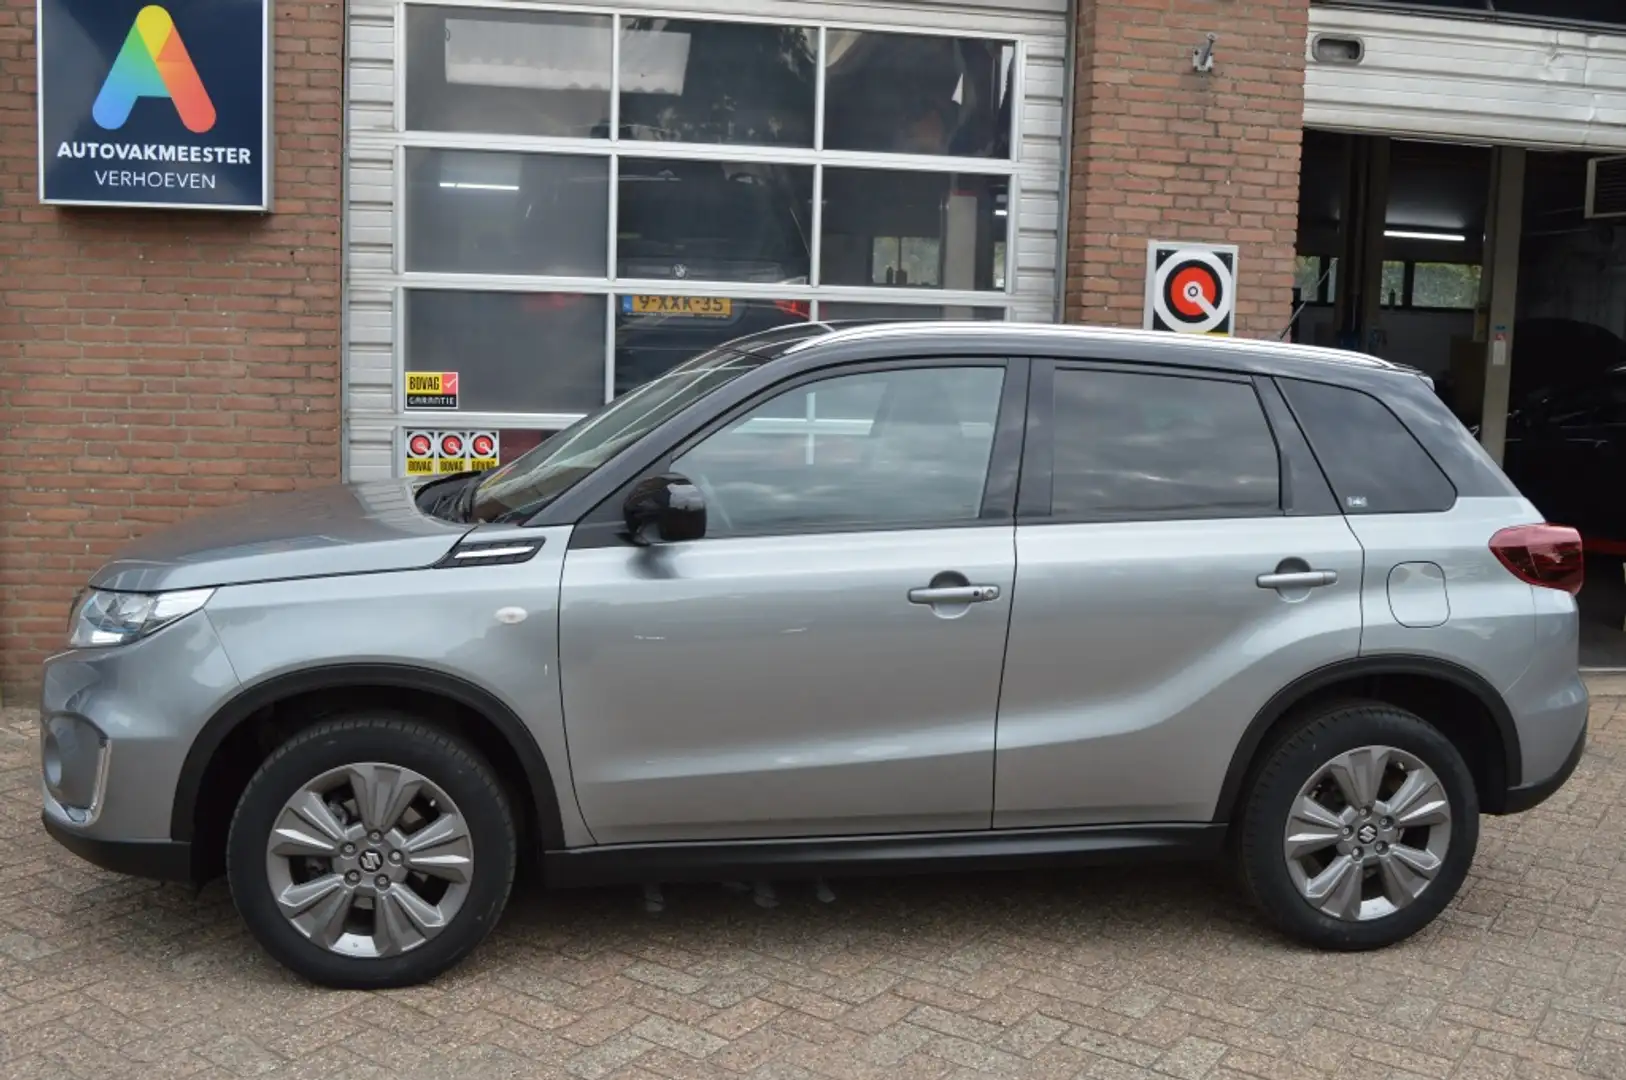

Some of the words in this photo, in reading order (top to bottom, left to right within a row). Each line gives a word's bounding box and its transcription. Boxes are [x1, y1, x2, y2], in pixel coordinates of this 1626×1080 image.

[57, 141, 252, 165] AUTOVAKMEESTER
[94, 170, 216, 189] VERHOEVEN
[410, 376, 439, 390] BOVAG
[408, 461, 431, 471] BOVAG
[440, 461, 463, 471] BOVAG
